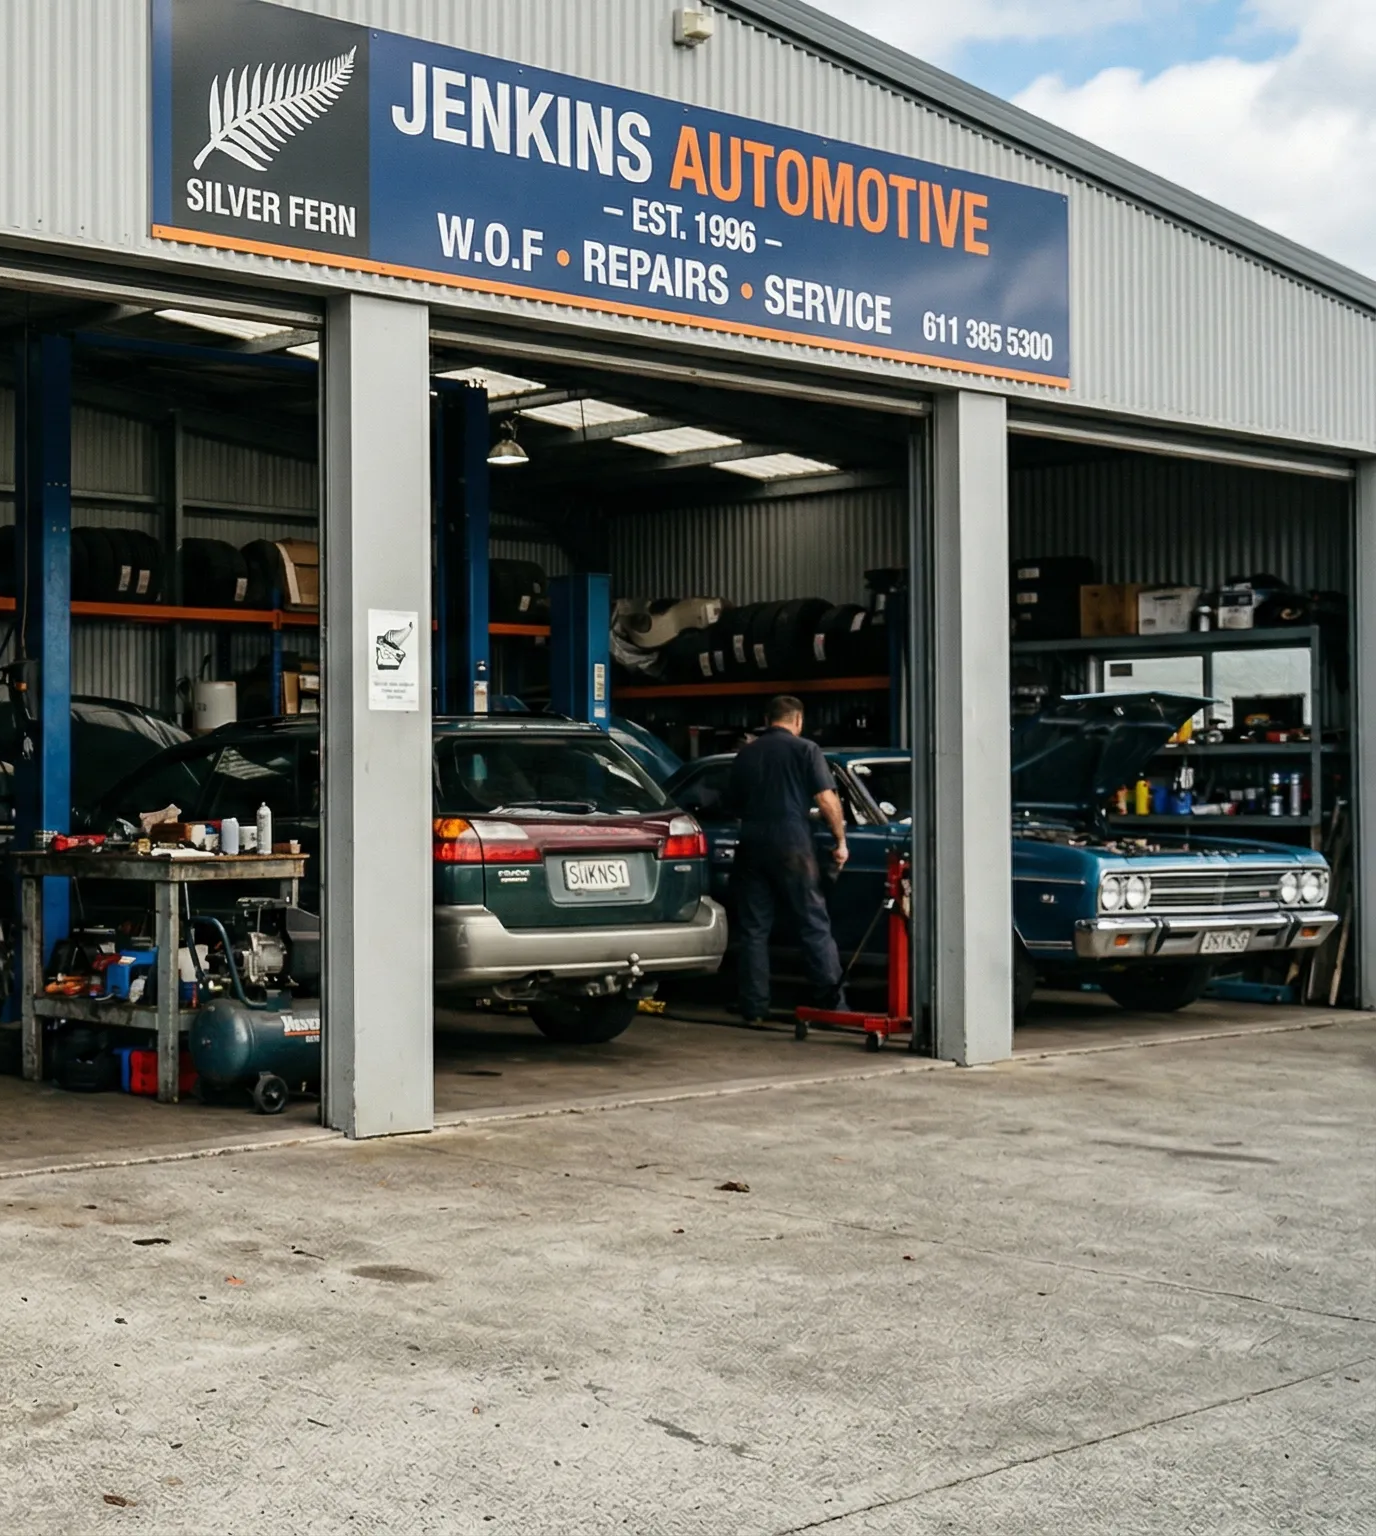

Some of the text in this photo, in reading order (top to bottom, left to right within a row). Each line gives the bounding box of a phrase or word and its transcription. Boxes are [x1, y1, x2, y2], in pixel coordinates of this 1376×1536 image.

[391, 62, 990, 257] JENKINS AUTOMOTIVE
[186, 177, 357, 238] SILVER FERN
[632, 197, 757, 254] EST. 1996
[436, 211, 893, 336] W.O.F REPAIRS SERVICE
[922, 310, 1054, 363] 611 385 5300
